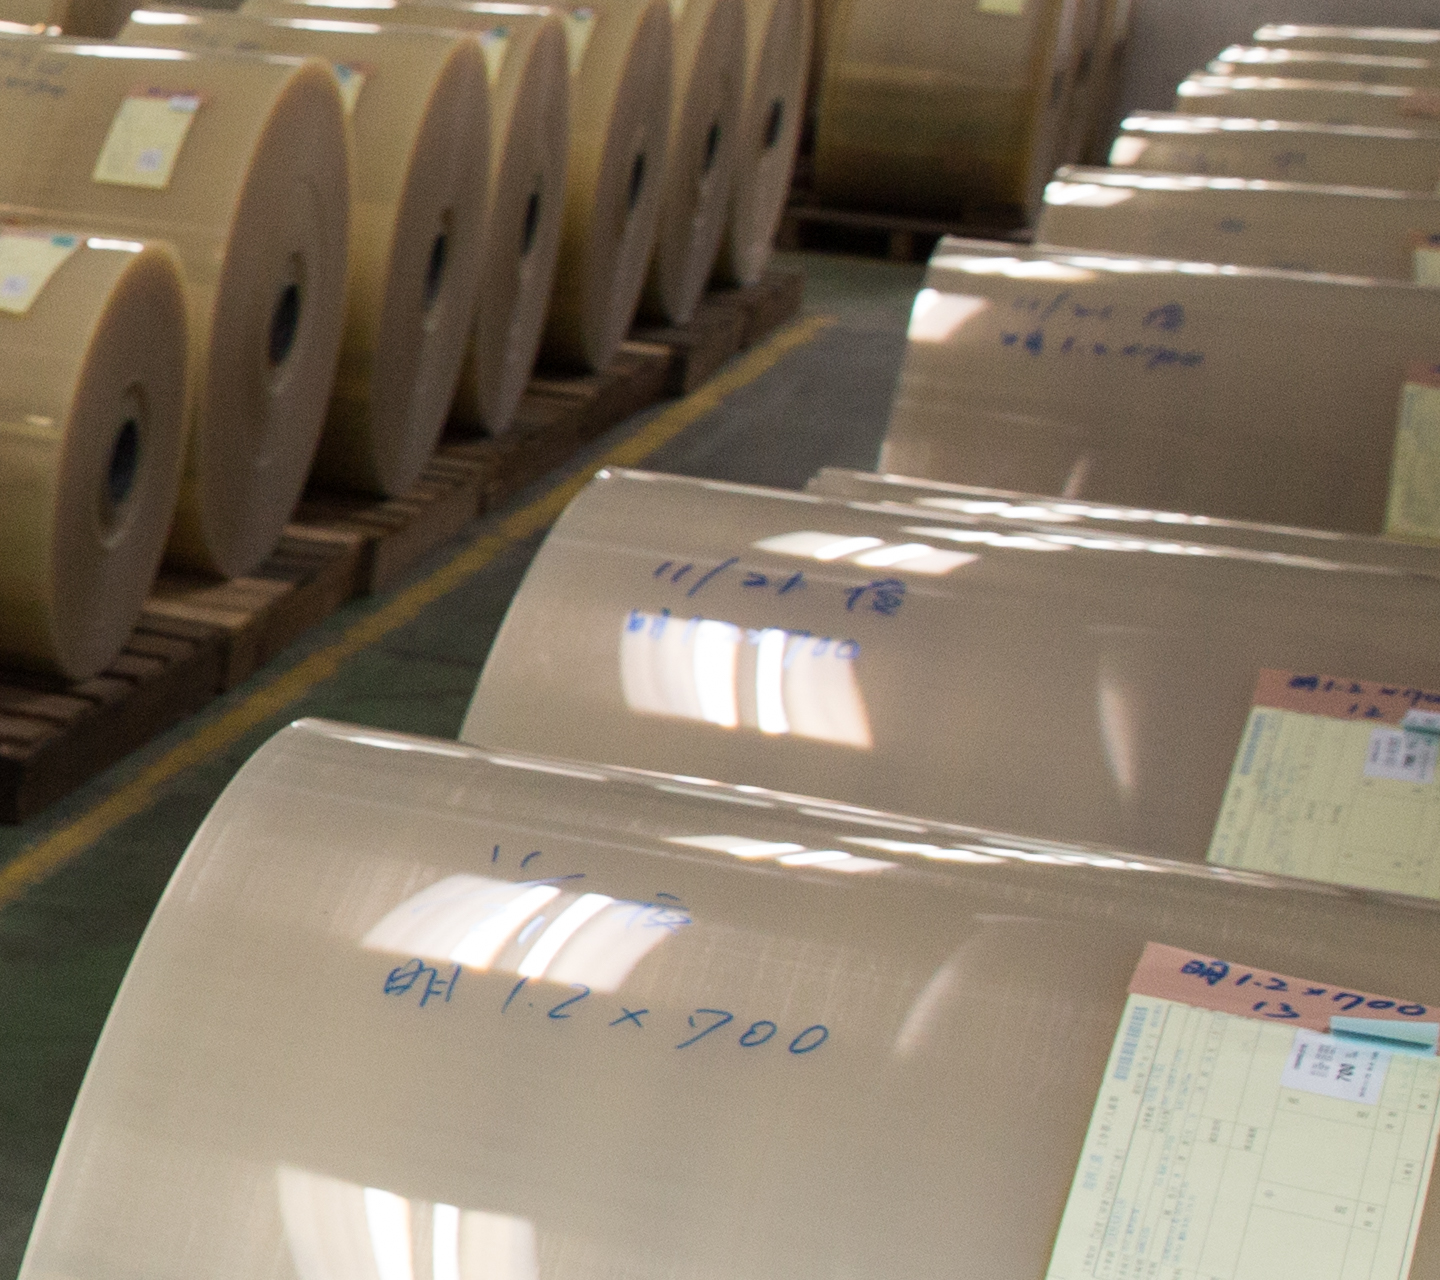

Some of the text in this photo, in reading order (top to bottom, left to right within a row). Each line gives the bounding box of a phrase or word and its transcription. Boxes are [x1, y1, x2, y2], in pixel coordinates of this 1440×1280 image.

[383, 958, 464, 1008] 明
[502, 976, 592, 1020] 1.2
[676, 1009, 830, 1055] 700
[1235, 973, 1289, 993] 1.2
[1331, 991, 1428, 1018] 700
[1252, 1000, 1301, 1020] 13
